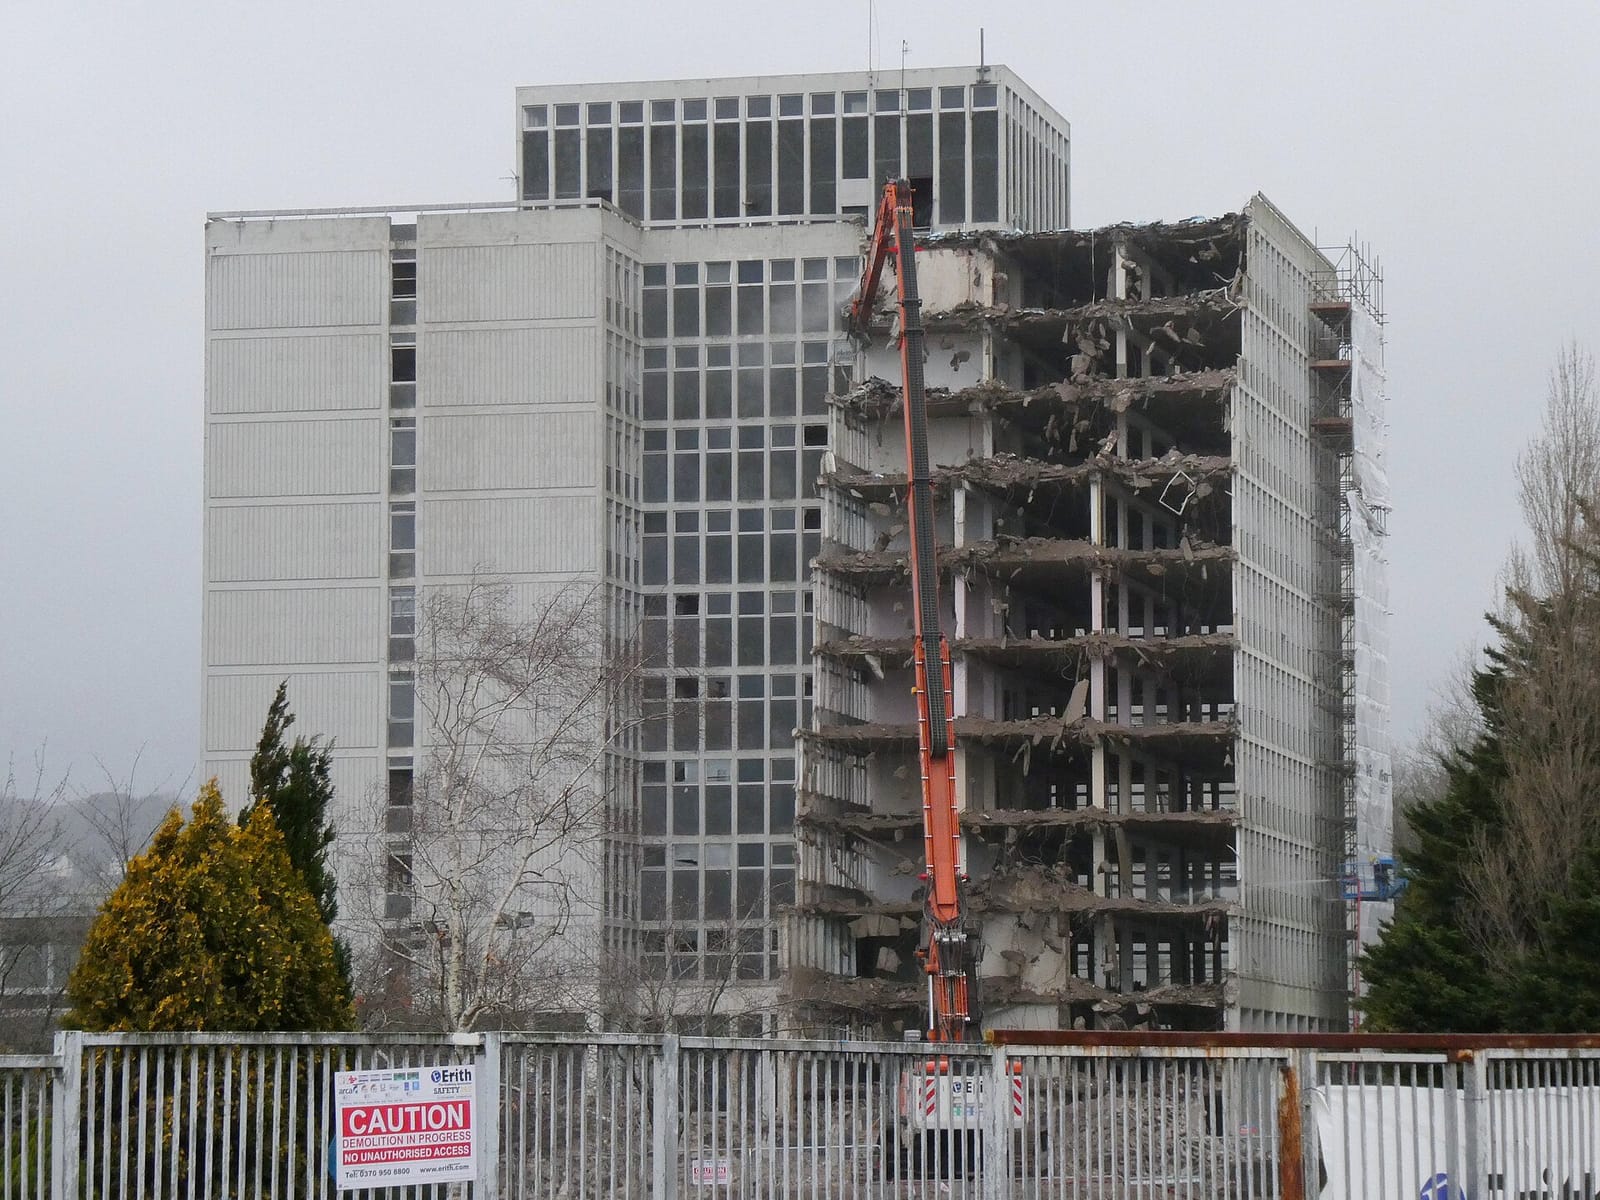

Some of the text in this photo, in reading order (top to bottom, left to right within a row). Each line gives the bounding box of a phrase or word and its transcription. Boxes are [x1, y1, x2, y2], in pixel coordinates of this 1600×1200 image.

[442, 1068, 472, 1083] Erith
[433, 1087, 460, 1095] SAFETY
[349, 1103, 463, 1135] CAUTION
[343, 1131, 471, 1149] DEMOLITION IN PROGRESS
[344, 1145, 470, 1163] NO UNAUTHORISED ACCESS
[359, 1170, 377, 1178] 0370
[420, 1163, 470, 1173] www.erith.com
